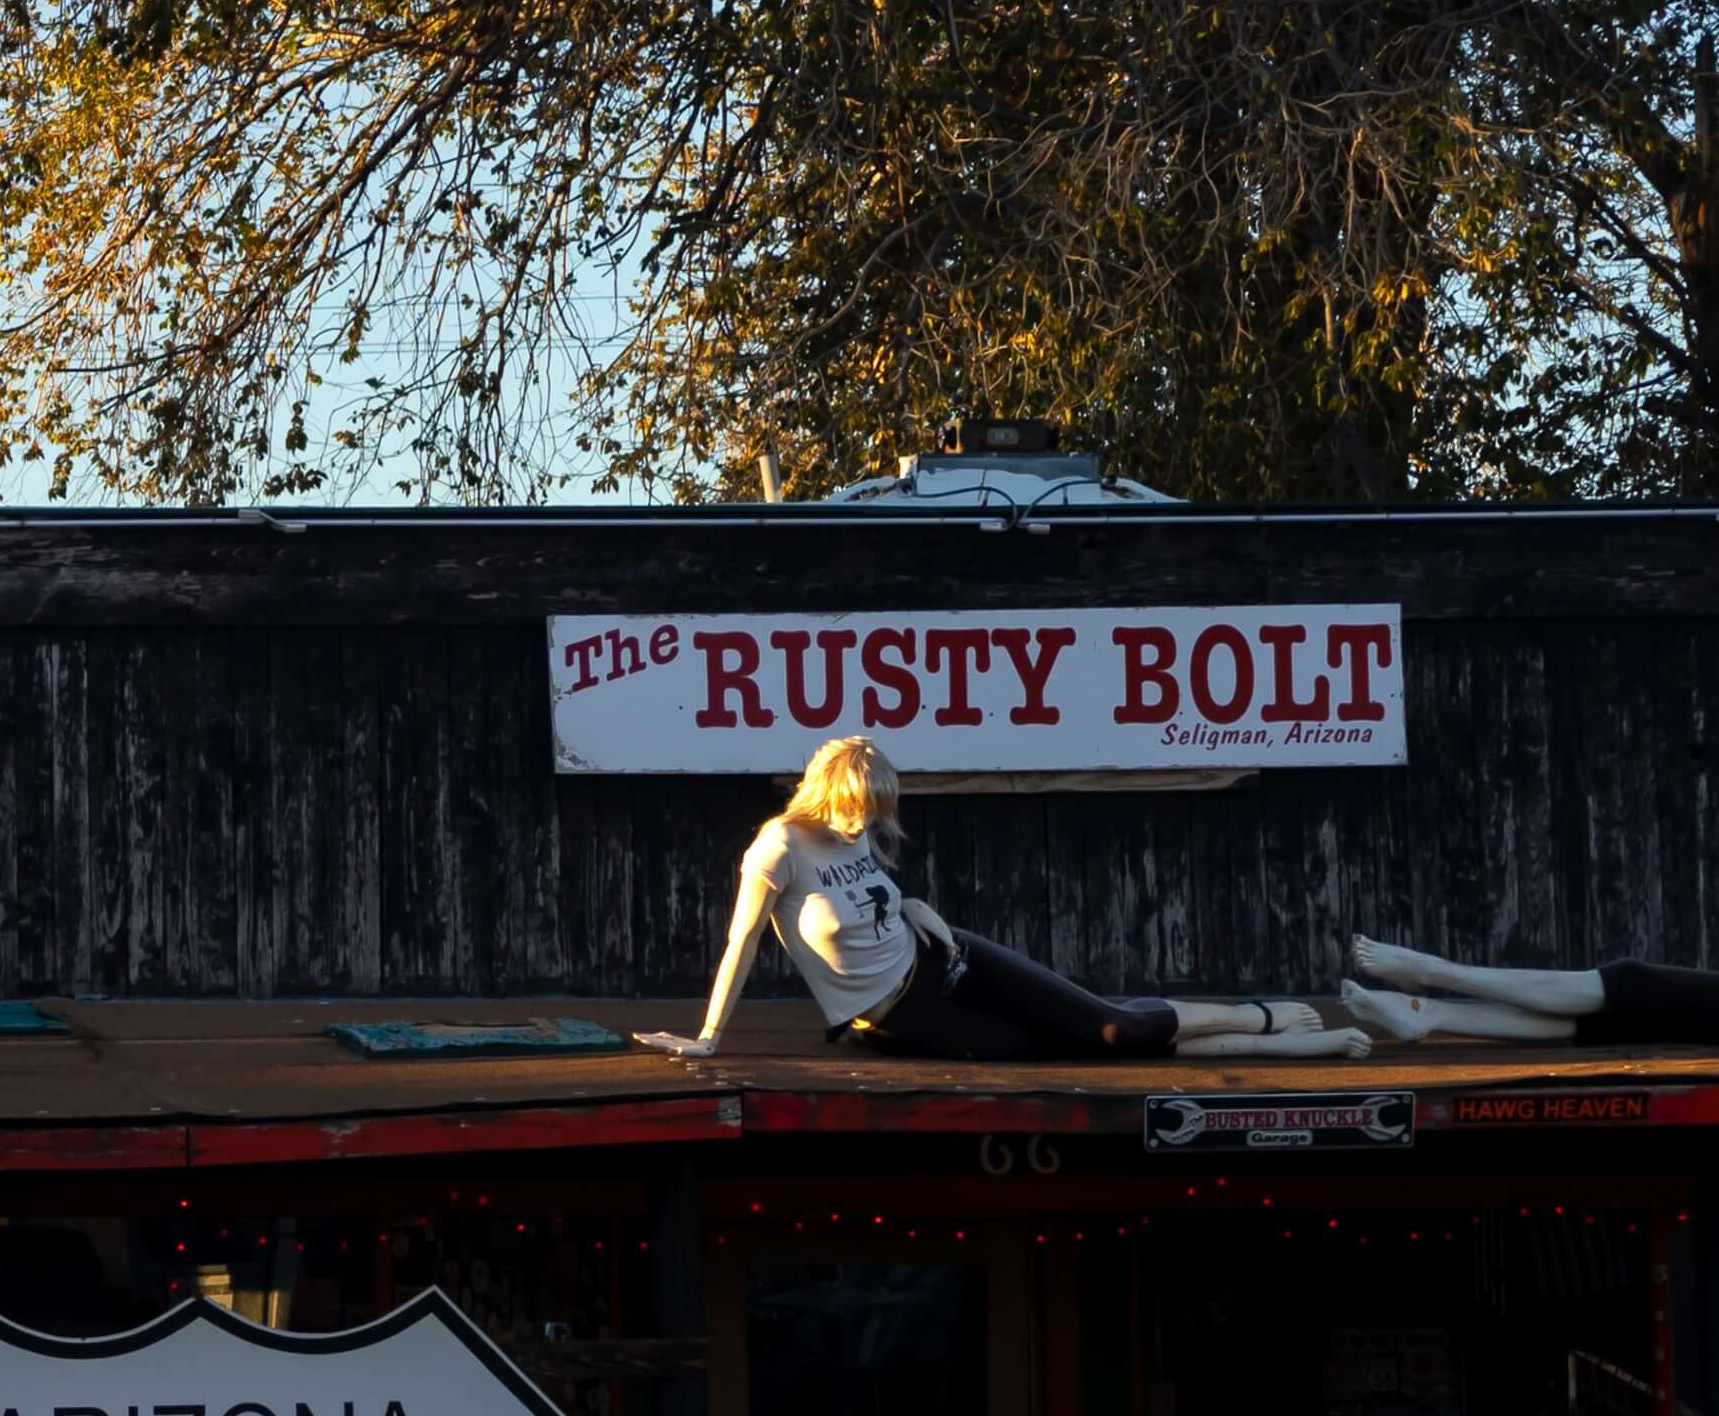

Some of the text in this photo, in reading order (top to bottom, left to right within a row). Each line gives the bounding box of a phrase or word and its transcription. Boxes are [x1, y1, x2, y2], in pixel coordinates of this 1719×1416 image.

[564, 623, 1393, 728] The RUSTY BOLT
[1161, 722, 1373, 750] Seligman, Arizona
[1205, 1108, 1373, 1128] BUSTED KNUCKLE
[1459, 1096, 1643, 1120] HAWG HEAVEN
[1251, 1132, 1308, 1145] Garage
